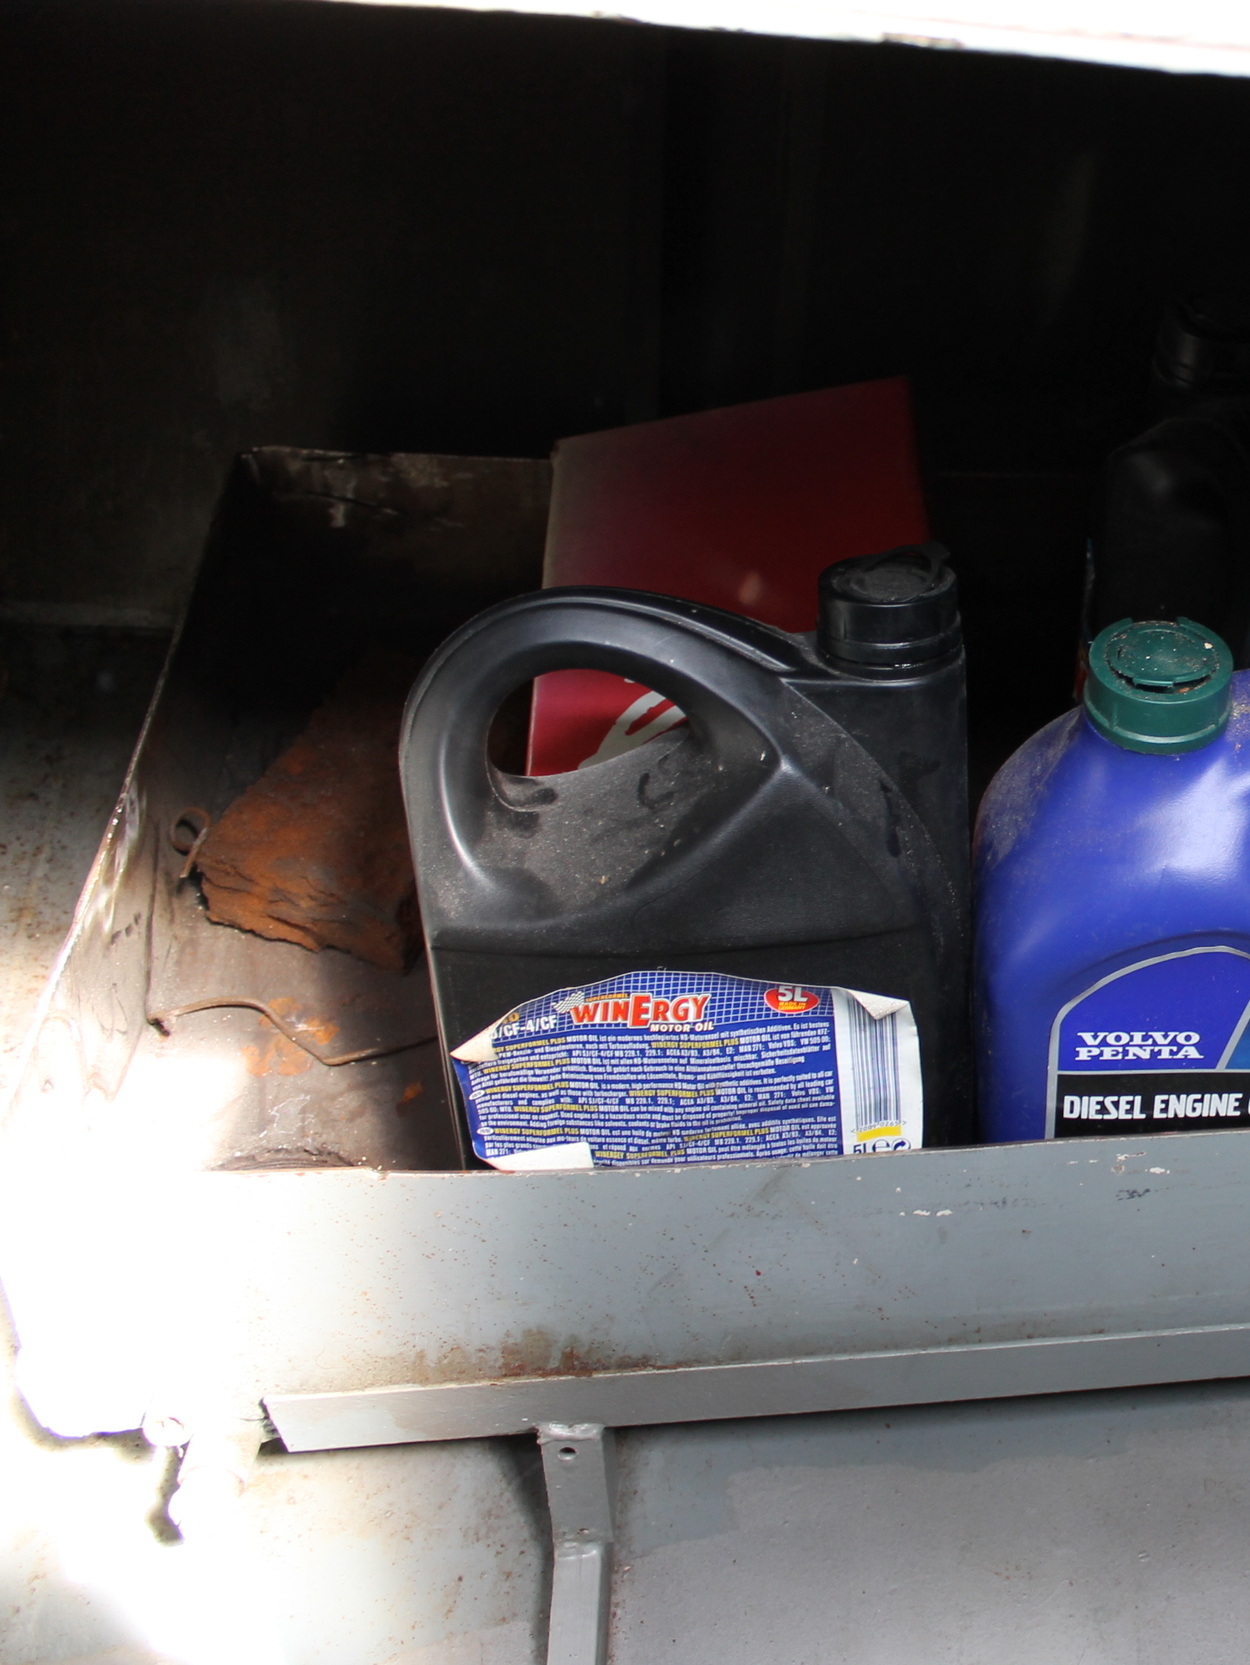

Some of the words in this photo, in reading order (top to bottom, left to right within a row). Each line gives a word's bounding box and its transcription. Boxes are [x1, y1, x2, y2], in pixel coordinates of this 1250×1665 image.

[778, 985, 809, 1002] 5L
[570, 993, 711, 1028] WINERGY
[492, 1014, 558, 1040] J/CF-4/CF
[649, 1023, 691, 1032] MOTOR
[694, 1020, 715, 1032] OIL
[1076, 1031, 1200, 1046] VOLVO
[1074, 1046, 1204, 1060] PENTA
[1062, 1094, 1147, 1120] DIESEL
[1152, 1092, 1243, 1119] ENGINE
